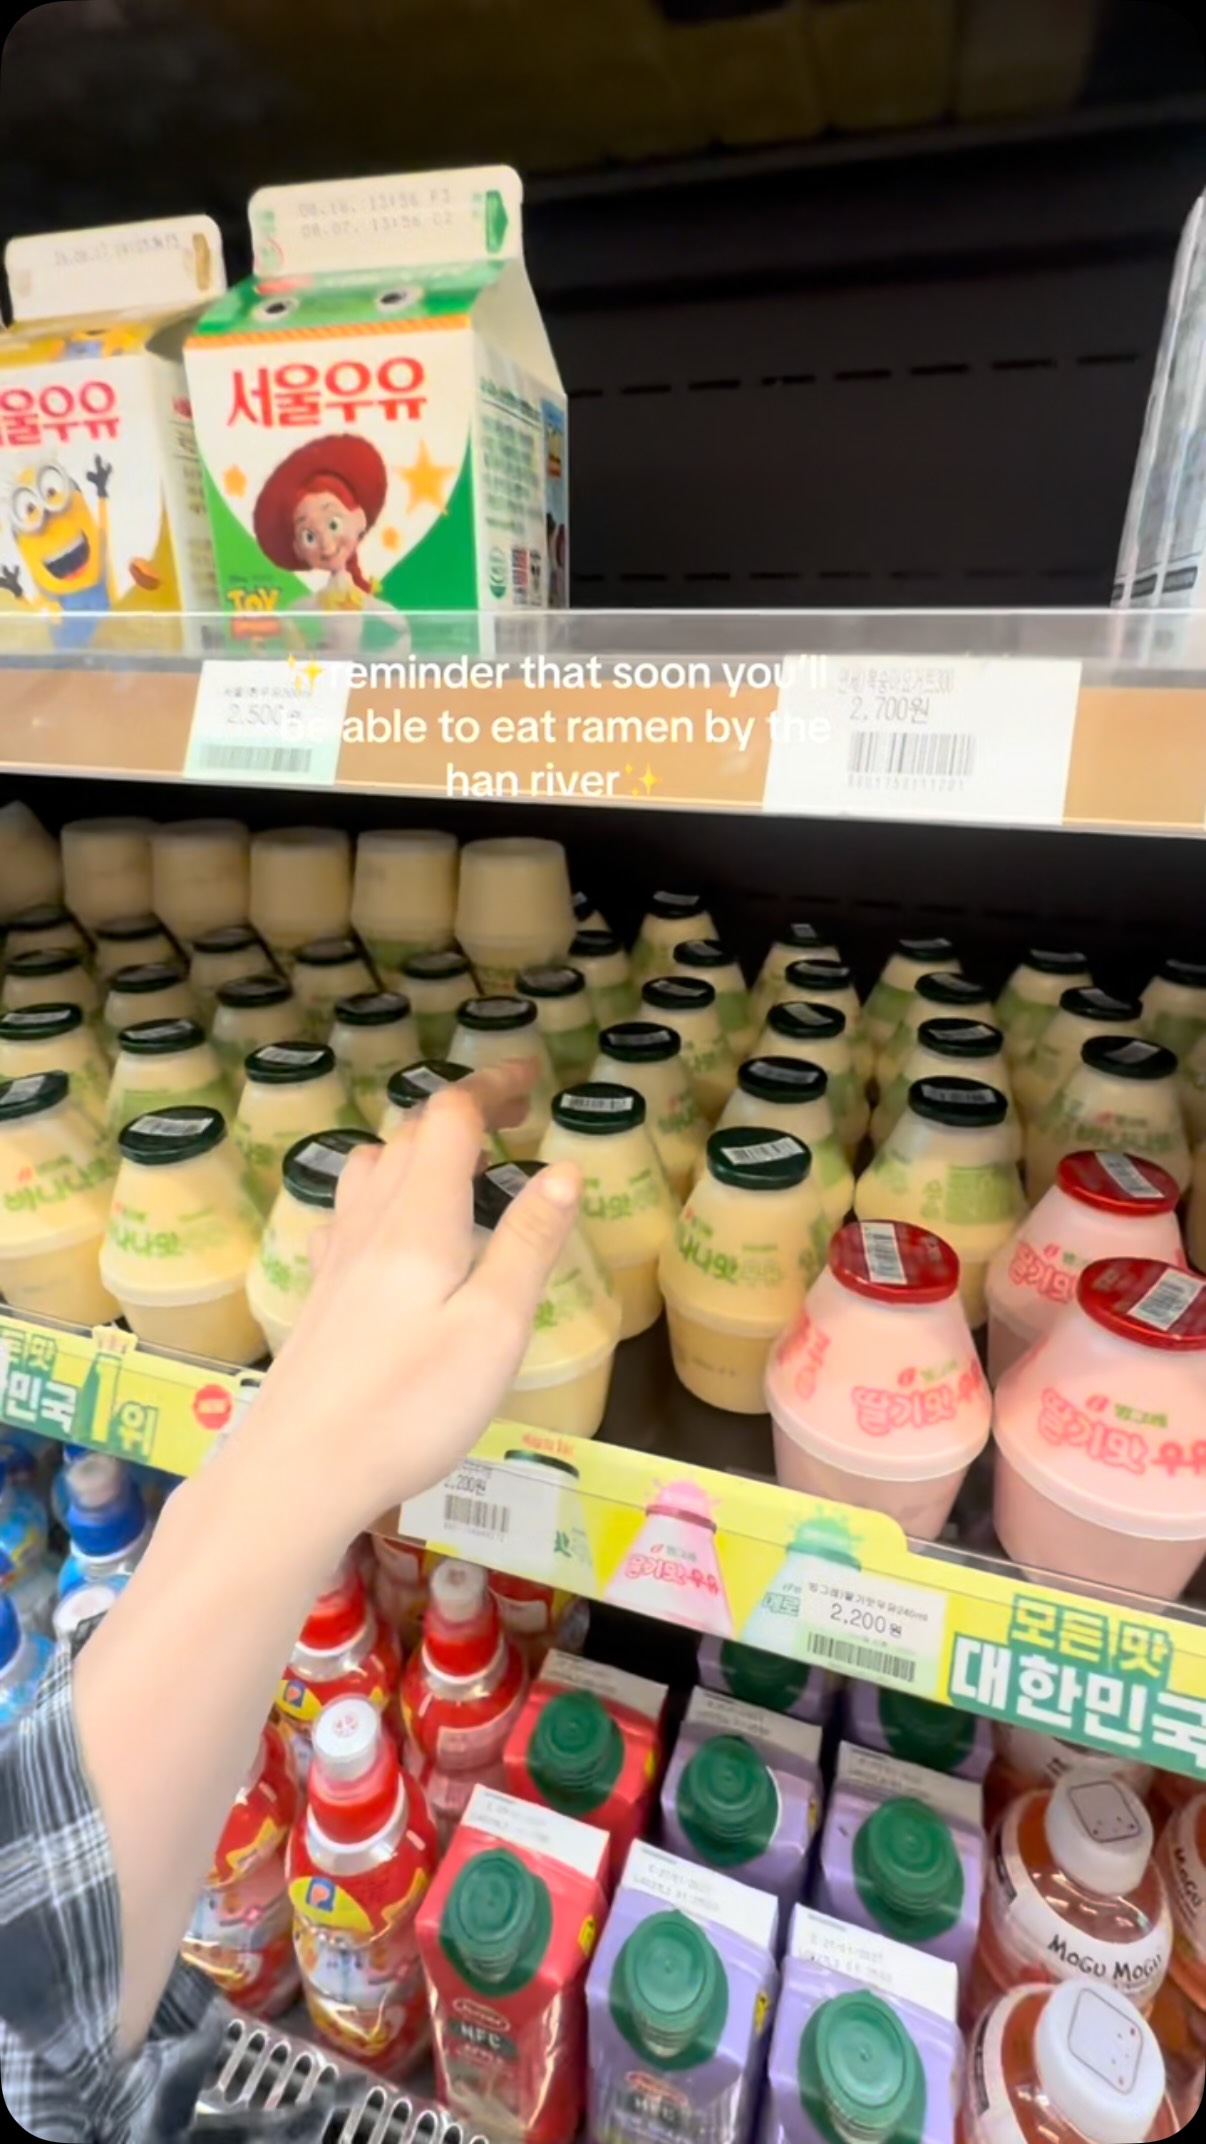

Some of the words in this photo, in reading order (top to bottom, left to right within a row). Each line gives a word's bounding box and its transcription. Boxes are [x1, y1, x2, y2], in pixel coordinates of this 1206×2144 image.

[0, 381, 120, 446] 울우유
[226, 356, 427, 429] 서울우유
[1011, 1596, 1106, 1664] 모든
[1118, 1623, 1172, 1679] 맛
[951, 1638, 1206, 1768] 대한민국
